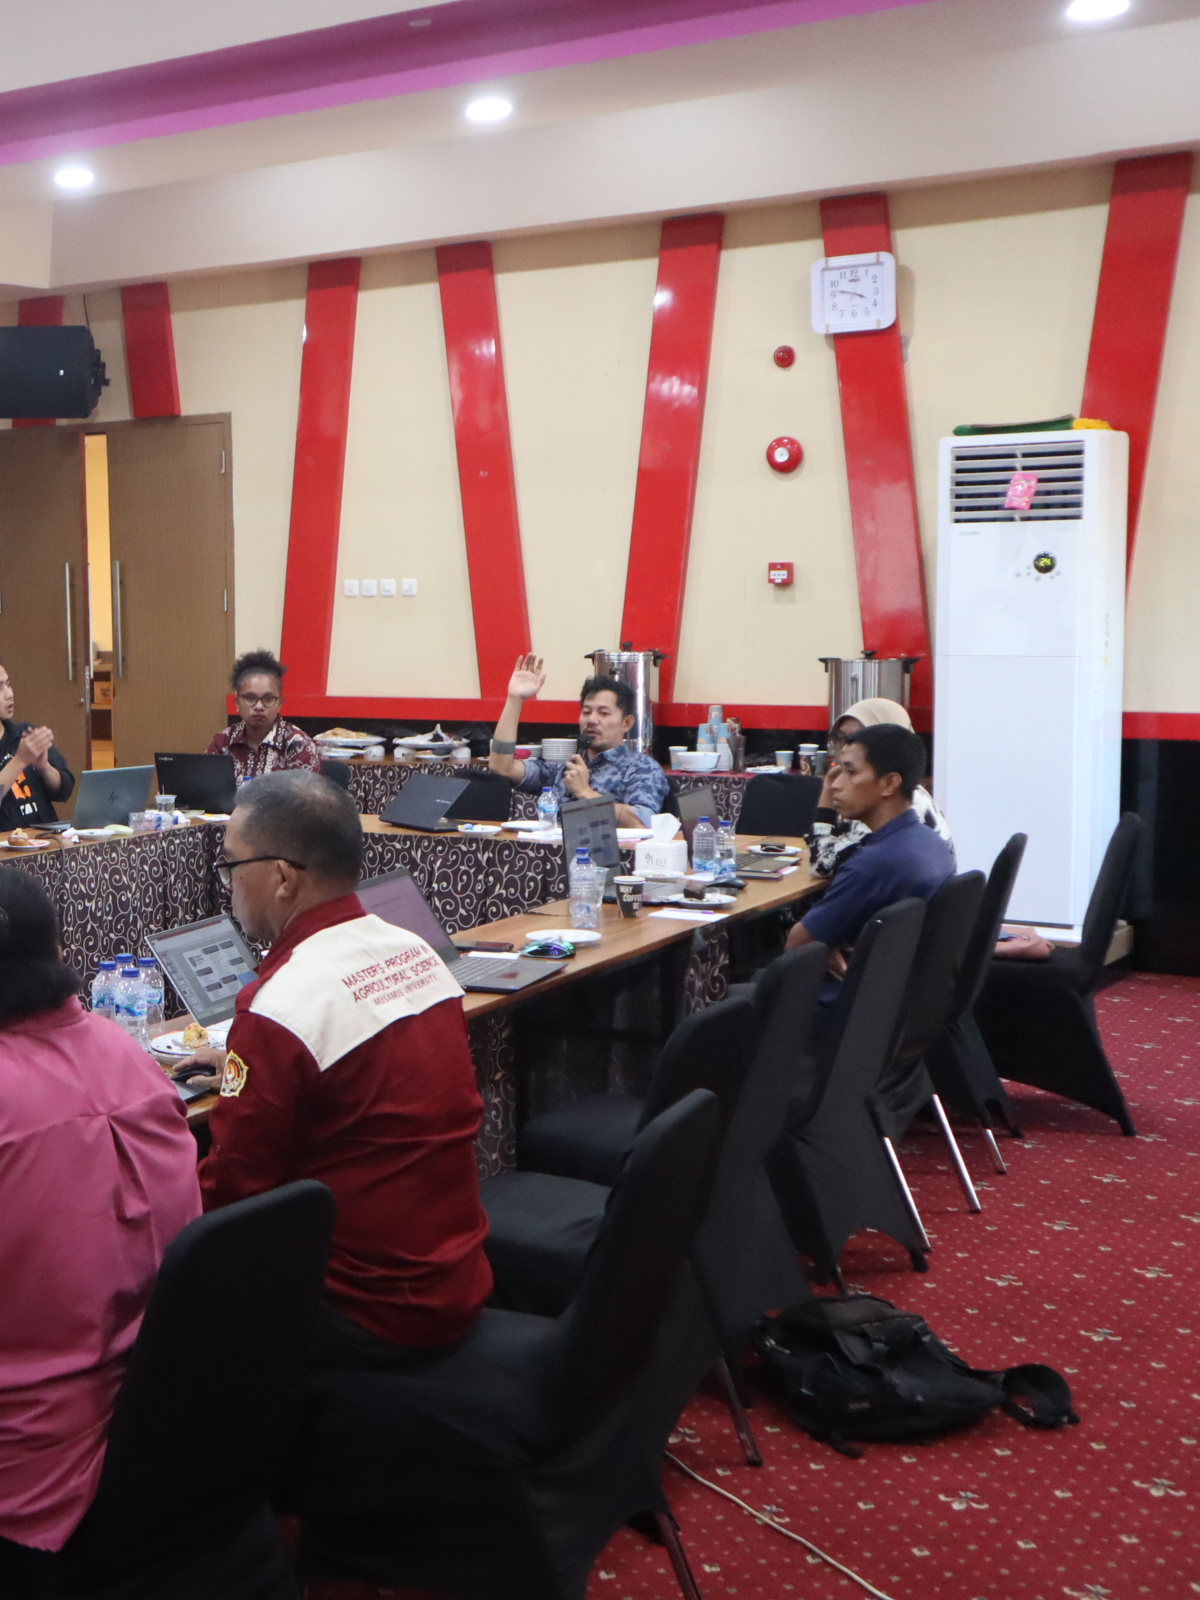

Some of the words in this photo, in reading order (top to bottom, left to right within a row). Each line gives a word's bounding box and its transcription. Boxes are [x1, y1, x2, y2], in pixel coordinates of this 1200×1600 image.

[830, 279, 839, 288] 10
[840, 271, 846, 279] 11
[850, 269, 858, 277] 12
[342, 963, 385, 989] MASTER'S
[385, 947, 421, 970] PROGRAM
[353, 969, 411, 1003] AGRICULTURAL
[411, 956, 439, 976] SCIENCE
[374, 988, 405, 1006] MUSAMUS
[404, 973, 437, 993] UNIVERSITY
